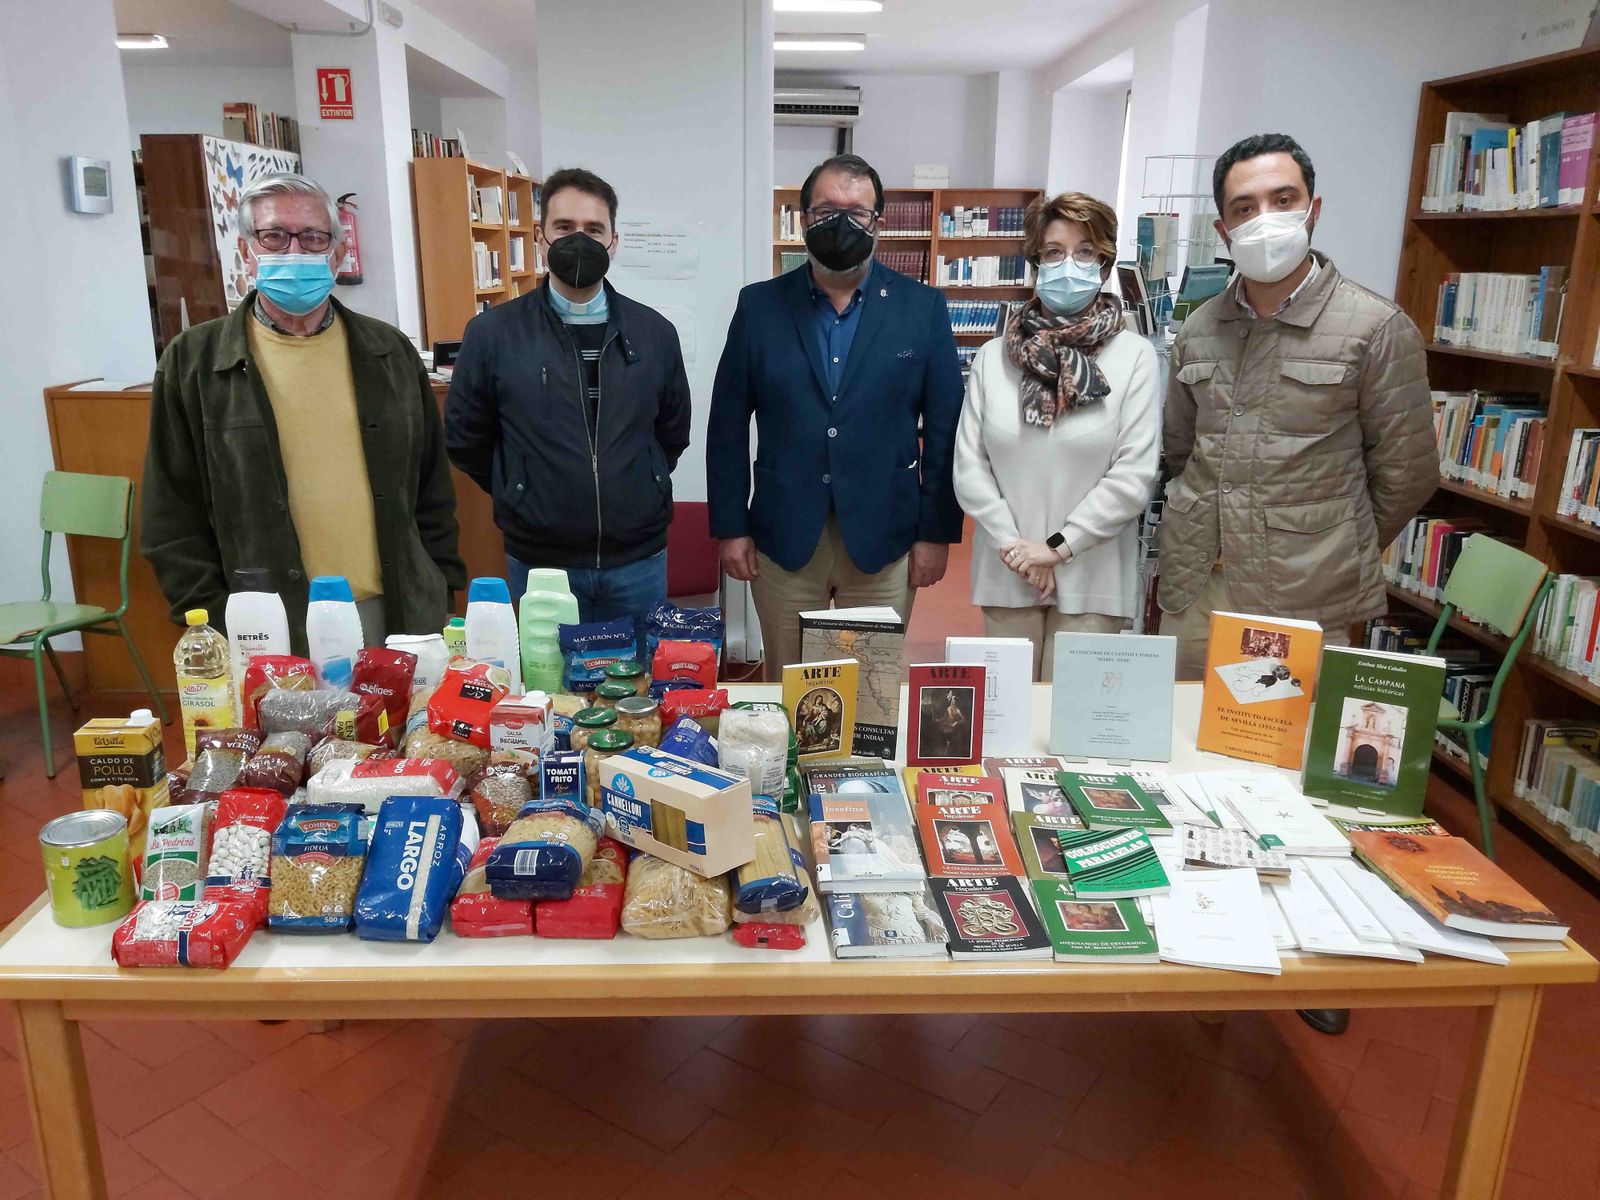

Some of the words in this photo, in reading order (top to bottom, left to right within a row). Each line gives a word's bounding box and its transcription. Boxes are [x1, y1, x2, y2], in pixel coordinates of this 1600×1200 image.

[322, 109, 352, 117] EXTINTOR
[573, 634, 612, 643] MACARRON
[801, 666, 842, 680] ARTE
[927, 668, 970, 679] ARTE
[1354, 674, 1365, 683] LA
[1368, 676, 1406, 690] CAMPANA
[182, 700, 216, 708] GIRASOL
[1232, 717, 1257, 728] SEVILLA
[858, 725, 895, 736] CONSULTAS
[862, 734, 885, 742] INDIAS
[94, 766, 134, 776] POLLO
[546, 768, 577, 776] TOMATE
[550, 776, 572, 784] FRITO
[938, 776, 980, 785] ARTE
[1078, 774, 1118, 784] ARTE
[606, 793, 642, 817] CANNELLONI
[938, 806, 982, 815] ARTE
[1034, 815, 1082, 825] ARTE
[432, 824, 447, 867] ARROZ
[1066, 830, 1144, 859] COLECCIONES
[397, 822, 426, 890] LARGO
[1076, 840, 1149, 868] PARALELAS
[232, 878, 261, 888] uengo
[946, 878, 999, 887] ARTE
[834, 893, 855, 919] Calí
